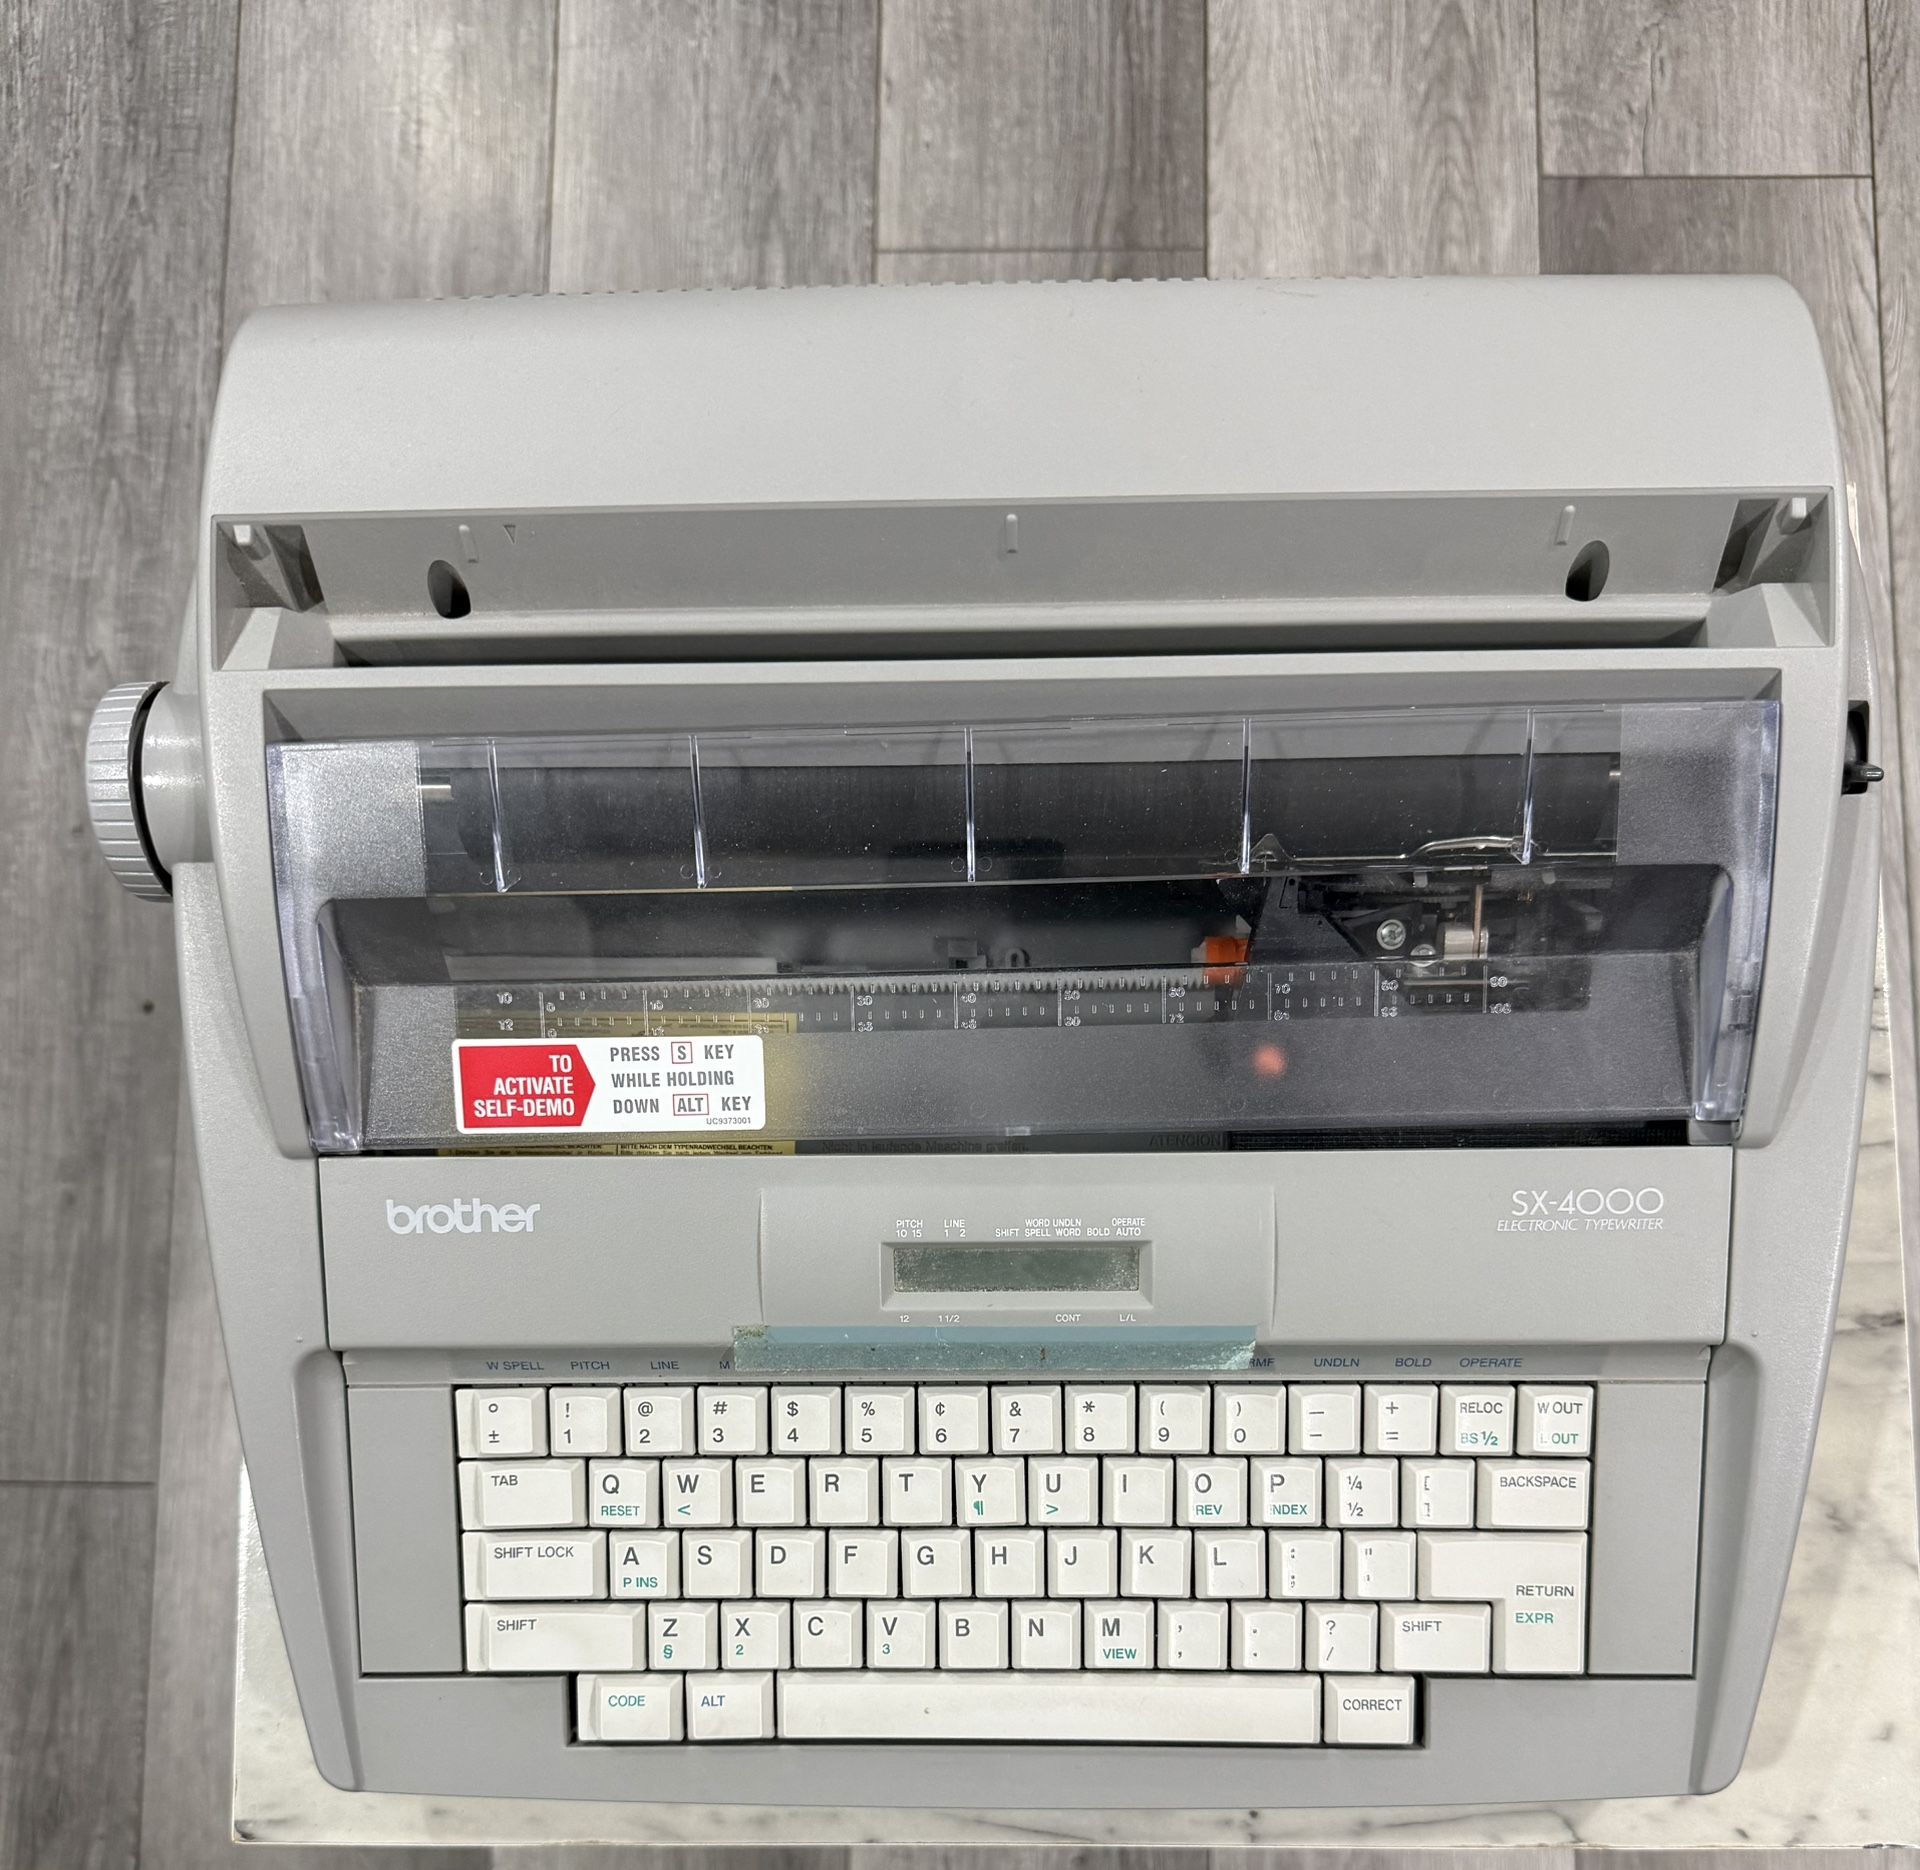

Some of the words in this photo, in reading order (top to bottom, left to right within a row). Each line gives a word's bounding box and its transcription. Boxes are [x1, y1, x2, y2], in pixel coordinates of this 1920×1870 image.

[610, 1046, 659, 1062] PRESS
[678, 1046, 686, 1060] S
[704, 1044, 734, 1059] KEY
[549, 1055, 572, 1072] TO
[494, 1077, 574, 1095] ACTIVATE
[611, 1073, 660, 1088] WHILE
[667, 1071, 734, 1086] HOLDING
[474, 1098, 574, 1117] SELF-DEMO
[613, 1099, 659, 1114] DOWN
[678, 1098, 703, 1111] ALT
[722, 1096, 751, 1111] KEY
[706, 1117, 750, 1125] UC9373001
[1512, 1188, 1664, 1216] SX-4000
[386, 1198, 540, 1234] brother
[945, 1219, 965, 1227] LINE
[1025, 1219, 1050, 1227] WORD
[1053, 1219, 1081, 1227] UNDLN
[1112, 1218, 1145, 1226] OPERATE
[896, 1220, 923, 1228] PITCH
[1497, 1219, 1578, 1231] ELECTRONIC
[1585, 1218, 1663, 1230] TYPEWRITER
[896, 1229, 907, 1237] 10
[912, 1229, 921, 1237] 15
[945, 1229, 948, 1237] 1
[960, 1229, 965, 1237] 2
[996, 1229, 1019, 1237] SHIFT
[1025, 1229, 1051, 1237] SPELL
[1055, 1228, 1081, 1236] WORD
[1087, 1228, 1110, 1236] BOLD
[1116, 1227, 1141, 1236] AUTO
[900, 1314, 910, 1322] 12
[1056, 1314, 1080, 1322] CONT
[486, 1361, 498, 1370] W
[503, 1361, 544, 1370] SPELL
[571, 1361, 609, 1370] PITCH
[651, 1361, 679, 1369] LINE
[1314, 1358, 1359, 1367] UNDLN
[1395, 1358, 1431, 1367] BOLD
[1460, 1358, 1523, 1367] OPERATE
[638, 1402, 653, 1417] @
[713, 1402, 727, 1414] #
[787, 1401, 798, 1417] $
[861, 1402, 875, 1416] %
[1010, 1402, 1021, 1416] &
[1461, 1402, 1502, 1414] RELOC
[1537, 1402, 1549, 1413] W
[1553, 1402, 1583, 1414] OUT
[564, 1429, 571, 1443] 1
[640, 1429, 650, 1443] 2
[713, 1428, 724, 1442] 3
[787, 1428, 798, 1442] 4
[862, 1428, 872, 1442] 5
[936, 1428, 947, 1443] 6
[1010, 1428, 1019, 1442] 7
[1084, 1427, 1094, 1441] 8
[1159, 1427, 1169, 1442] 9
[1461, 1432, 1478, 1444] BS
[1552, 1433, 1579, 1444] OUT
[491, 1475, 518, 1486] TAB
[603, 1474, 619, 1494] Q
[677, 1475, 699, 1493] W
[751, 1474, 765, 1493] E
[825, 1474, 839, 1492] R
[899, 1474, 913, 1492] T
[972, 1474, 986, 1493] Y
[1046, 1474, 1060, 1493] U
[1271, 1474, 1284, 1492] P
[1500, 1476, 1576, 1488] BACKSPACE
[601, 1505, 639, 1516] RESET
[1196, 1505, 1222, 1515] REV
[495, 1547, 533, 1559] SHIFT
[538, 1546, 573, 1557] LOCK
[623, 1547, 639, 1565] A
[698, 1546, 712, 1565] S
[771, 1546, 786, 1564] D
[845, 1546, 857, 1564] F
[917, 1546, 934, 1565] G
[992, 1546, 1006, 1565] H
[1065, 1546, 1077, 1565] J
[1140, 1546, 1154, 1564] K
[1214, 1547, 1227, 1565] L
[624, 1578, 632, 1587] P
[636, 1577, 657, 1588] INS
[1516, 1585, 1574, 1596] RETURN
[497, 1619, 536, 1631] SHIFT
[1516, 1613, 1553, 1623] EXPR
[663, 1619, 678, 1637] Z
[735, 1618, 750, 1636] X
[808, 1617, 823, 1636] C
[882, 1617, 897, 1635] V
[956, 1619, 970, 1636] B
[1029, 1618, 1043, 1636] N
[1103, 1618, 1120, 1636] M
[1326, 1620, 1335, 1635] ?
[1402, 1621, 1442, 1632] SHIFT
[736, 1644, 743, 1655] 2
[883, 1644, 890, 1654] 3
[1103, 1648, 1136, 1659] VIEW
[608, 1695, 645, 1707] CODE
[701, 1695, 725, 1706] ALT
[1343, 1699, 1402, 1710] CORRECT
